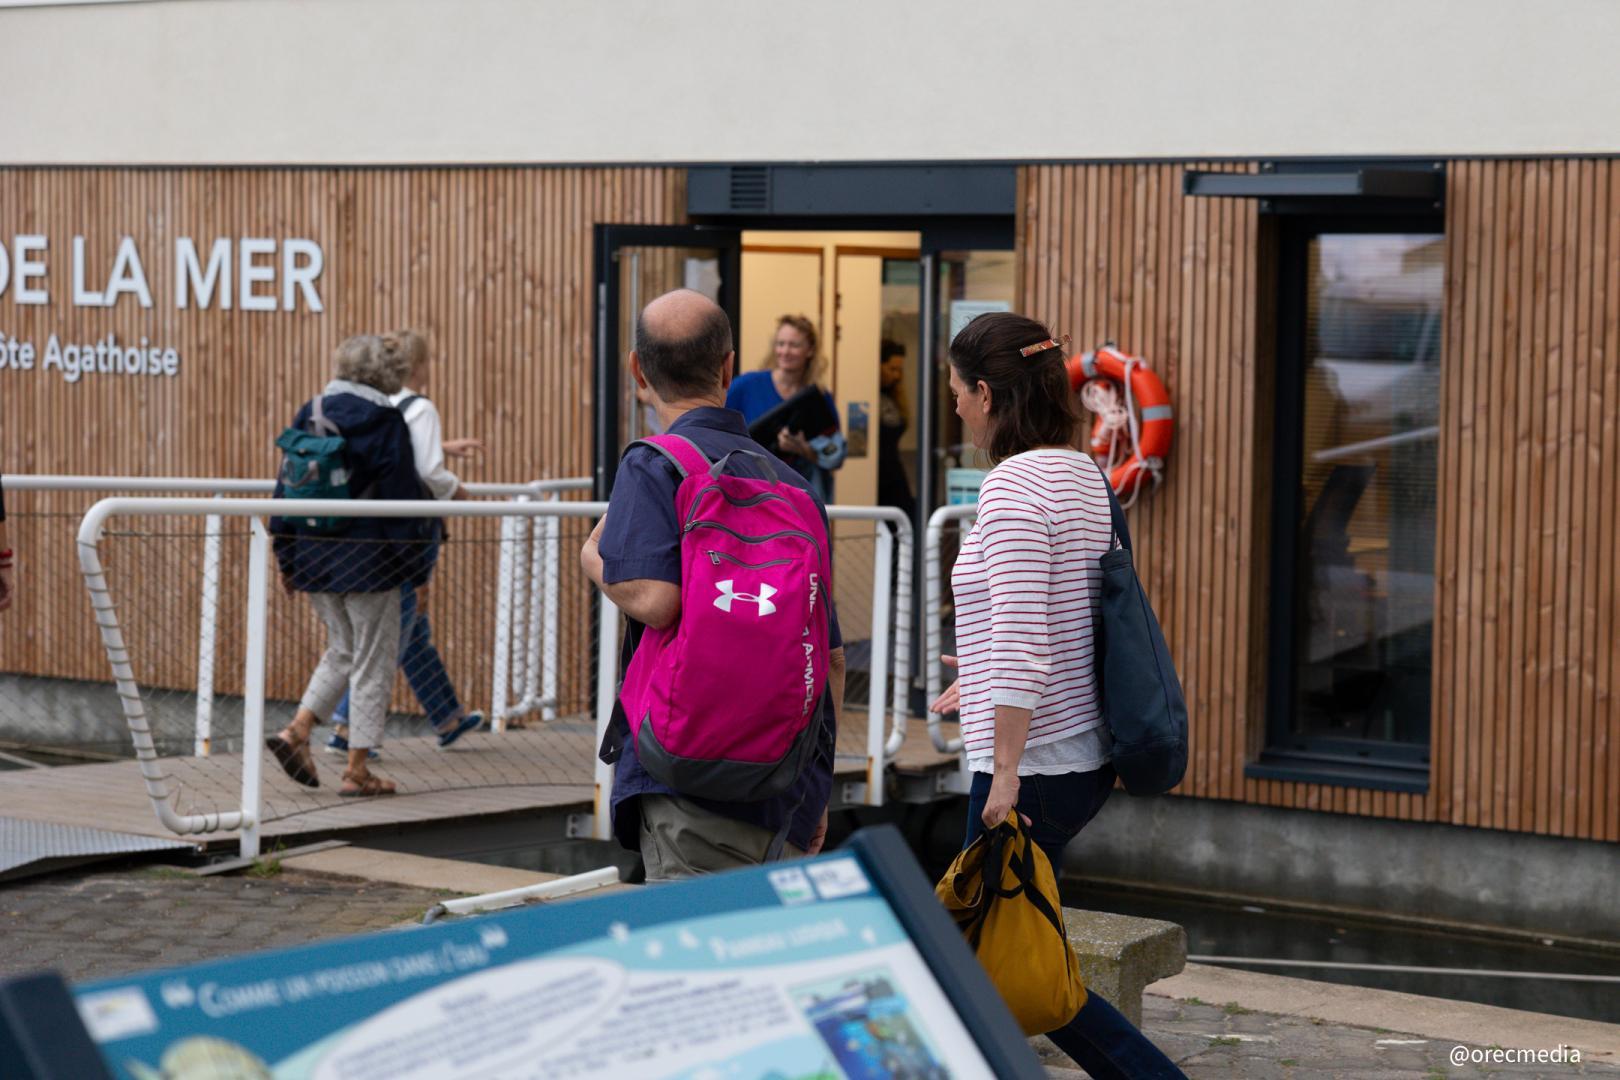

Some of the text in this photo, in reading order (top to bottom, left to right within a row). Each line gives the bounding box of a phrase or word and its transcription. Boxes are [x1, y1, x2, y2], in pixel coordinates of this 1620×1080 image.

[0, 235, 324, 312] E LA MER
[43, 333, 179, 383] Agathoise
